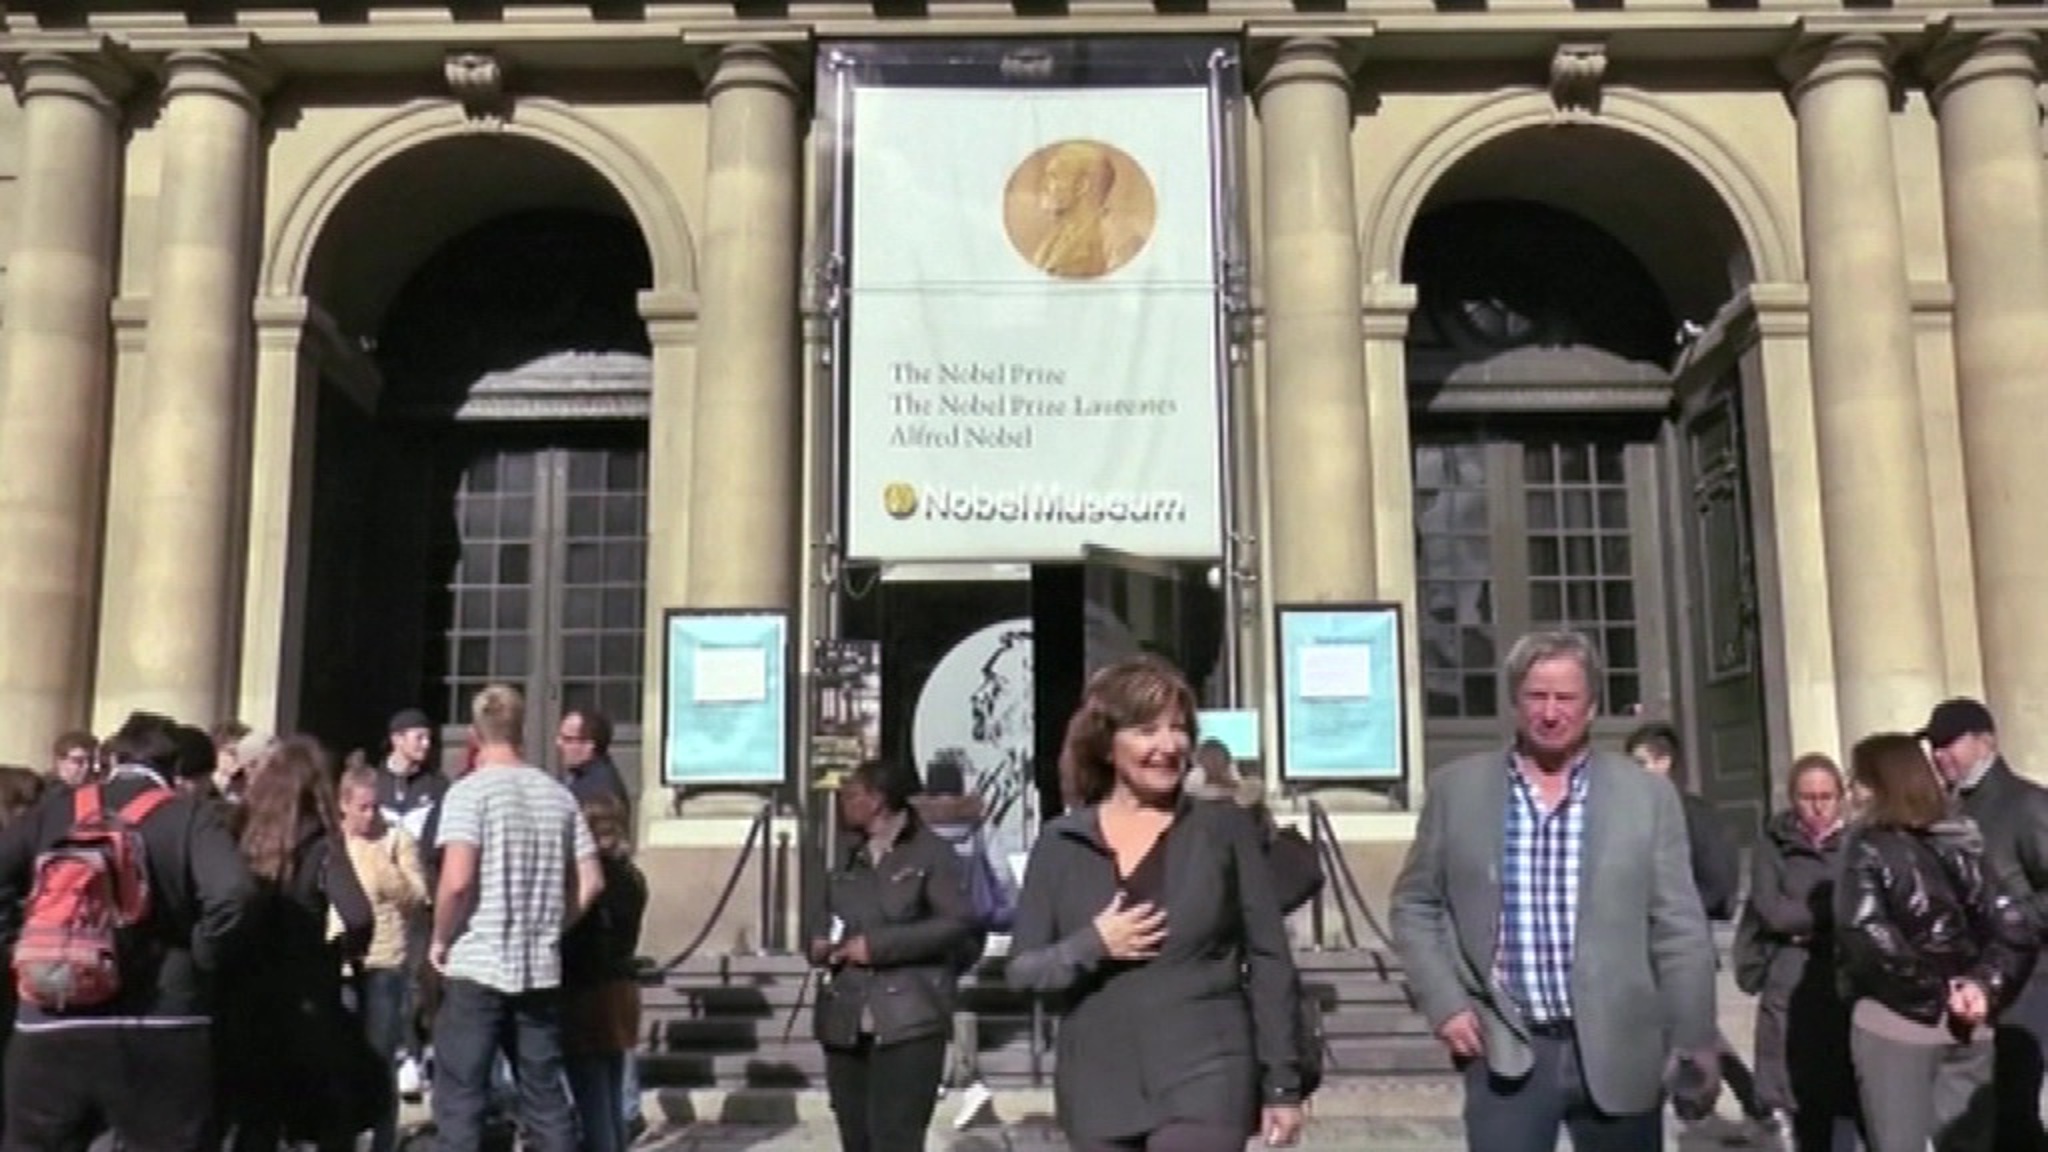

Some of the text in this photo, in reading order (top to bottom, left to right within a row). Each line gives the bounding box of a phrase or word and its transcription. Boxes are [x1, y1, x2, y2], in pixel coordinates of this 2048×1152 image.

[891, 363, 1066, 385] The Nobel Prize
[891, 395, 930, 417] The
[939, 395, 1005, 417] Nobel
[1010, 395, 1066, 417] Prize
[889, 426, 1032, 449] Alfred Nobel
